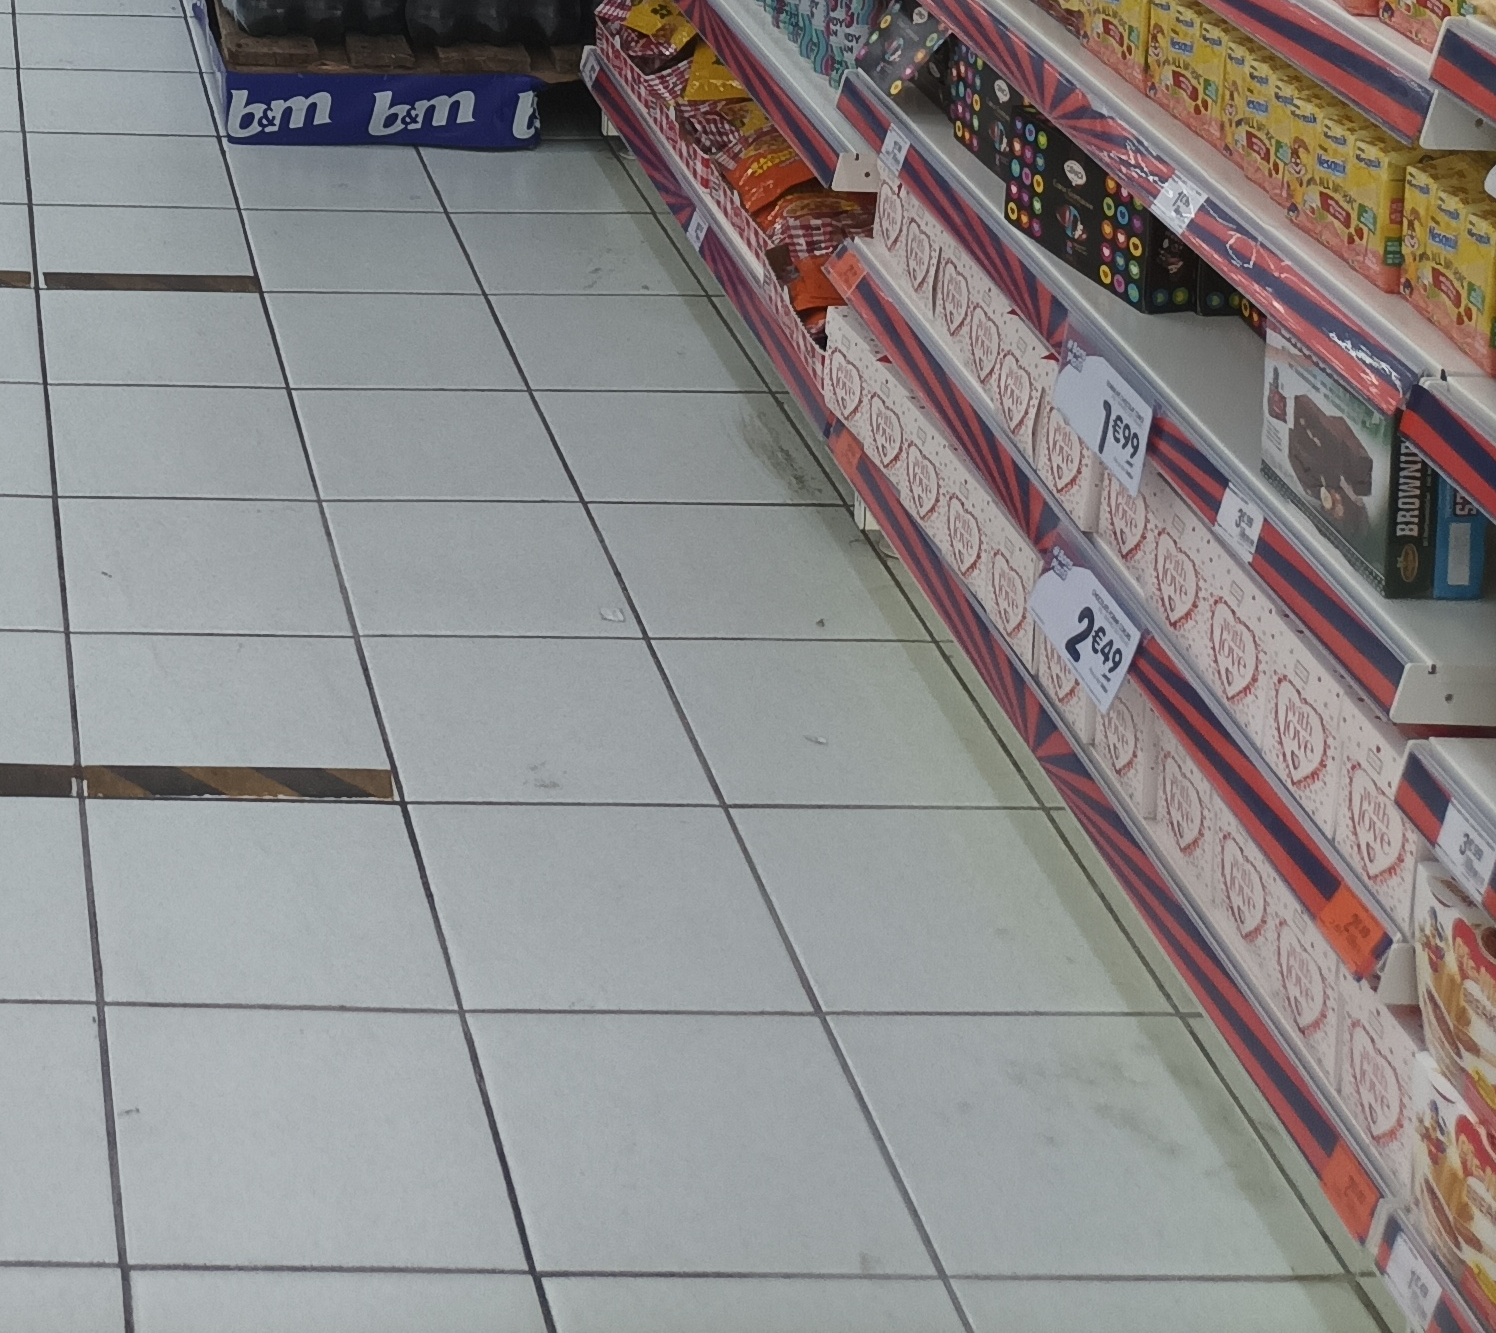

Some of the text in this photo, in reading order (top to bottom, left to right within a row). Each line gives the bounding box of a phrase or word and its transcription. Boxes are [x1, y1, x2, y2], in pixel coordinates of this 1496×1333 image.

[227, 88, 333, 138] b&m
[367, 89, 476, 137] b&m
[1098, 399, 1139, 459] 1€99
[1065, 606, 1122, 674] 2€49
[1218, 635, 1246, 677] love
[1222, 620, 1246, 652] with
[1283, 713, 1315, 761] love
[1287, 699, 1313, 732] with
[1358, 803, 1392, 854] love
[1363, 789, 1390, 825] with
